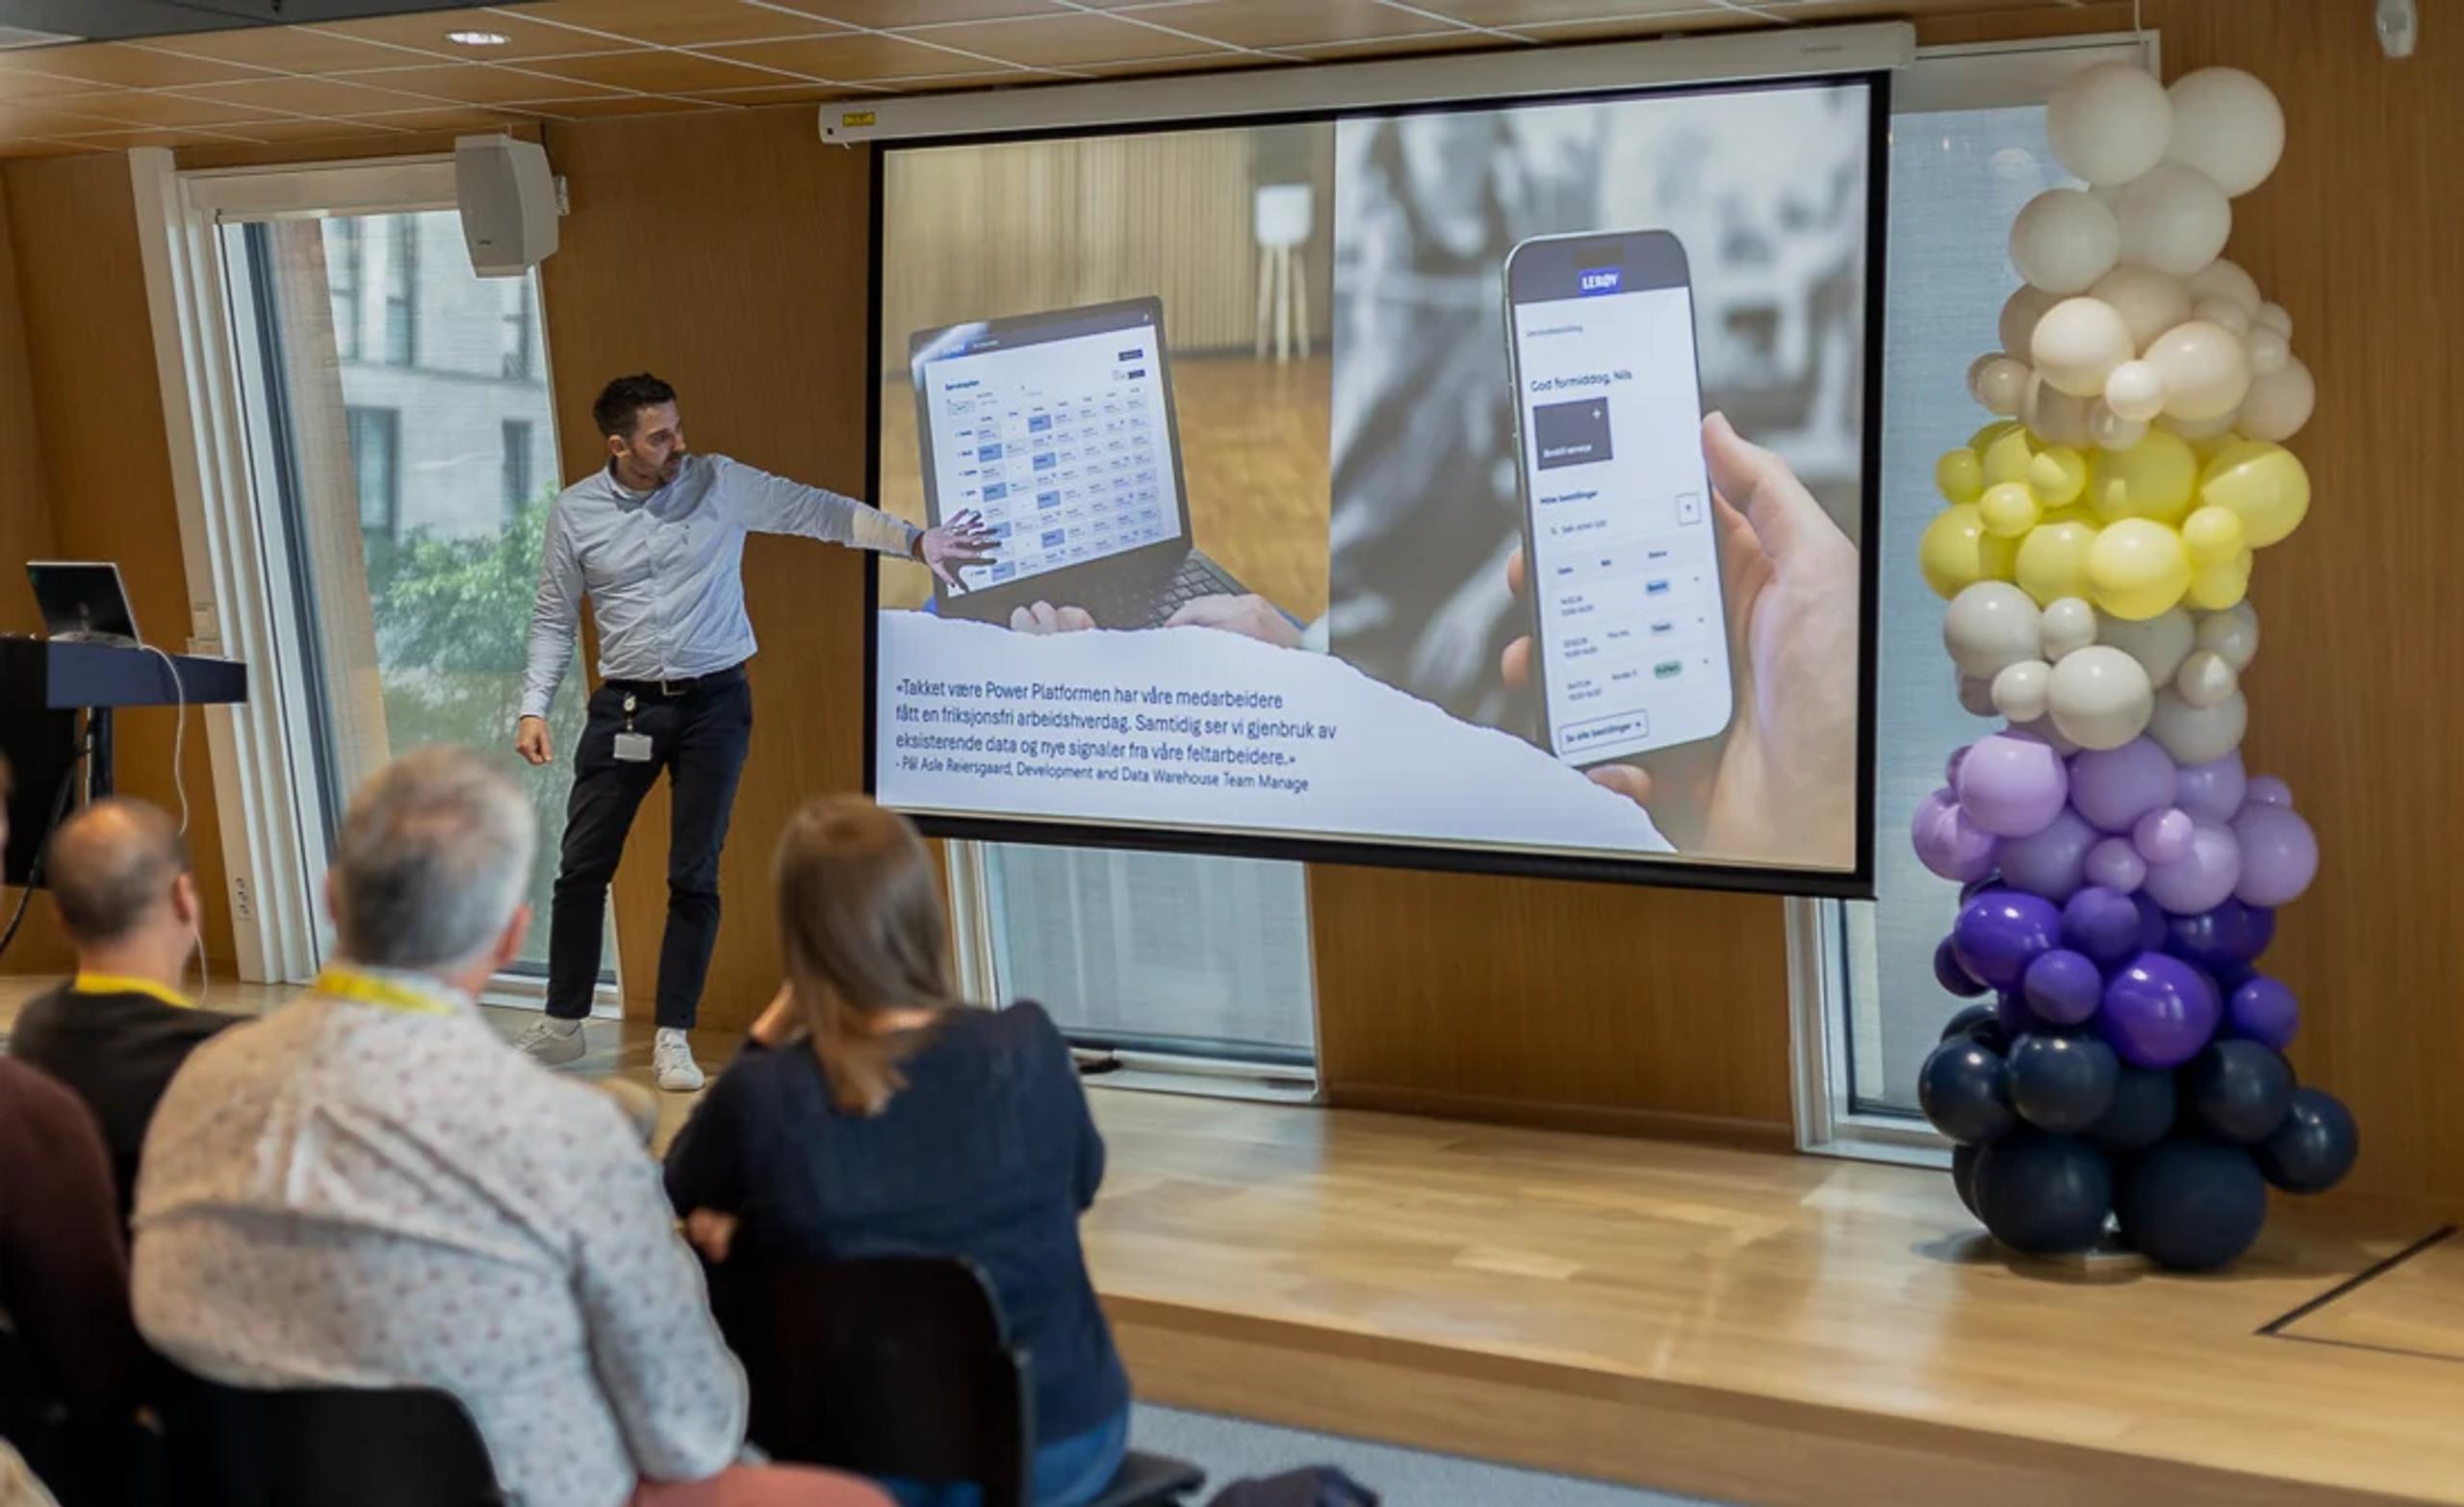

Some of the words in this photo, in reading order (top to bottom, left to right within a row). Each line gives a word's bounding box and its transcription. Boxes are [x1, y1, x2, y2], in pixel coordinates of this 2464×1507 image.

[947, 683, 983, 699] være
[986, 681, 1029, 700] Power
[1032, 682, 1111, 703] Platformen
[1114, 686, 1138, 703] har
[1142, 685, 1172, 705] våre
[1176, 690, 1283, 709] medarbeidere
[896, 703, 920, 722] fått
[922, 708, 939, 723] en
[941, 706, 1014, 728] friksjonsfri
[1016, 711, 1132, 733] arbeidshverdag.
[1135, 713, 1201, 737] Samtidig
[1204, 720, 1227, 735] ser
[1231, 720, 1245, 736] vi
[1247, 720, 1315, 740] gjenbruk
[1318, 725, 1337, 739] av
[896, 732, 983, 752] eksisterende
[986, 735, 1017, 754] data
[1020, 739, 1038, 757] og
[1041, 740, 1065, 758] nye
[1068, 739, 1126, 759] signaler
[1129, 741, 1148, 758] fra
[1151, 742, 1183, 761] våre
[920, 755, 943, 772] Asle
[1016, 760, 1093, 780] Development
[1095, 764, 1118, 780] and
[1121, 768, 1149, 783] Data
[1153, 769, 1220, 787] Warehouse
[1223, 772, 1255, 788] Team
[1259, 773, 1309, 794] Manage
